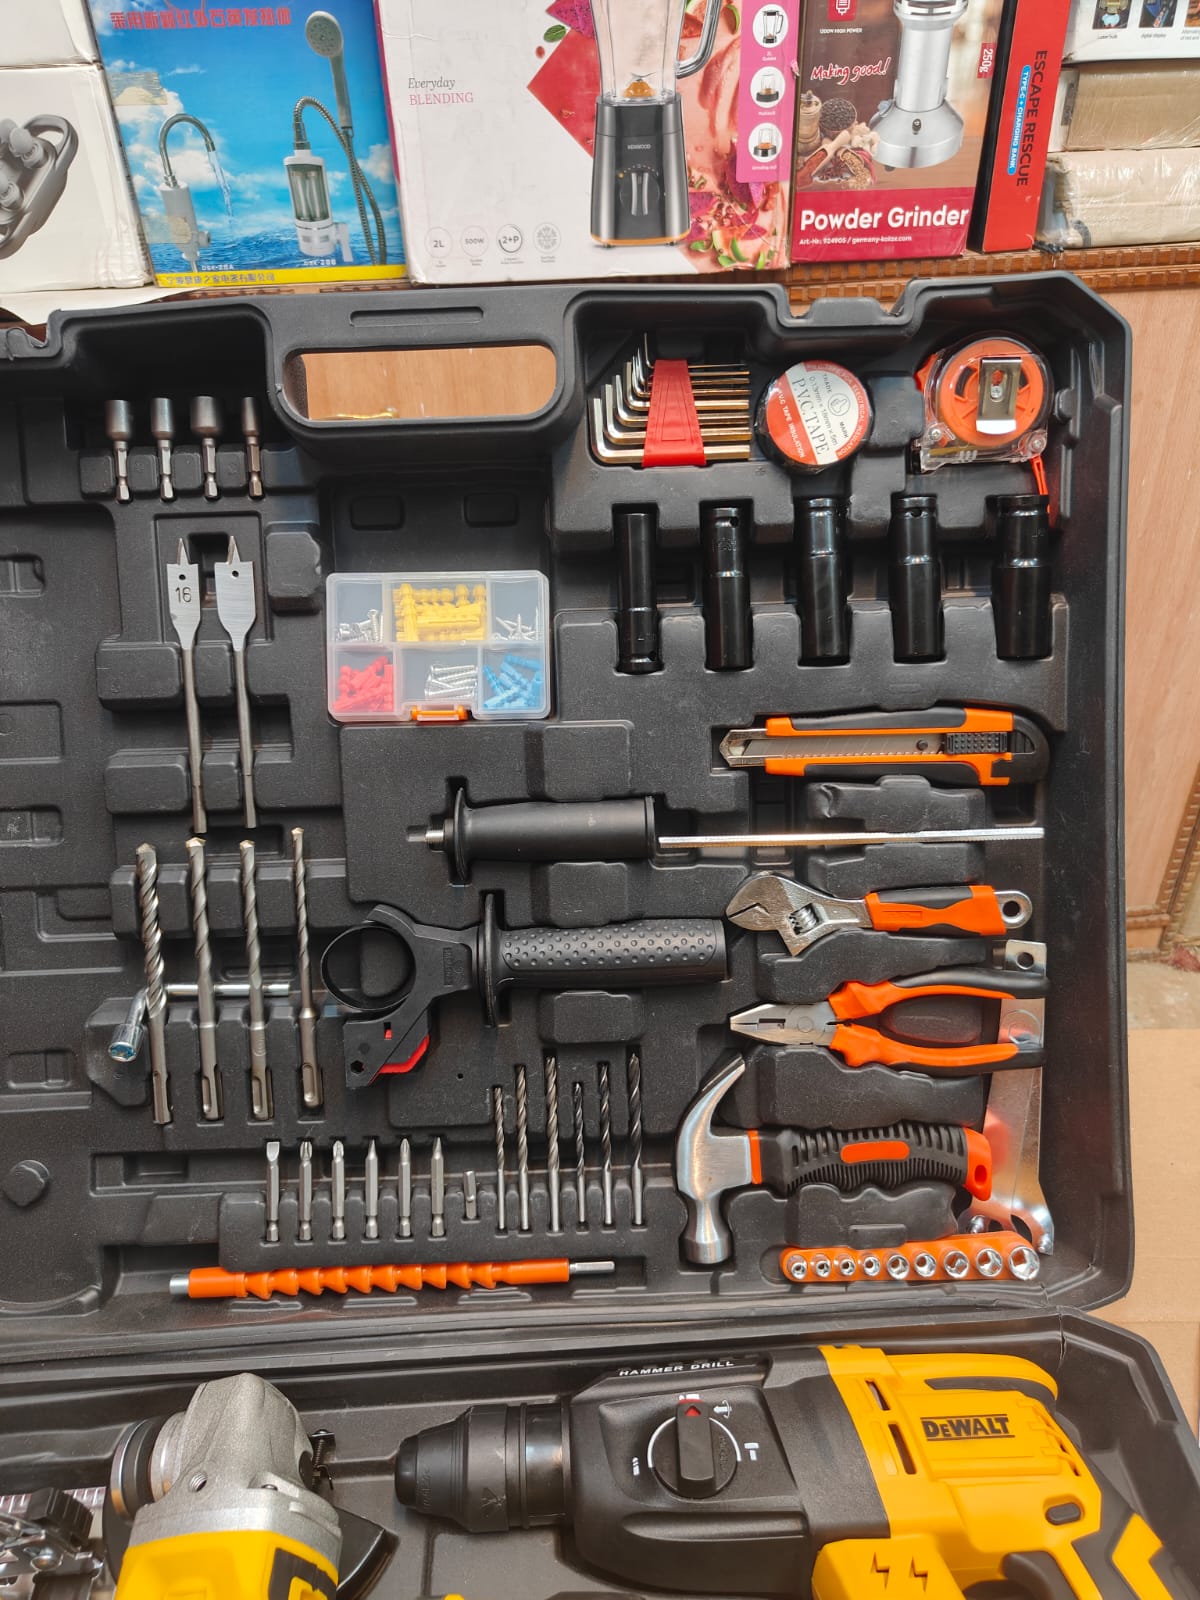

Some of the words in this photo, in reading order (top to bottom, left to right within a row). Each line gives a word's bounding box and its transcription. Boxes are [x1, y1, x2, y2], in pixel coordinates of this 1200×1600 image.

[810, 63, 850, 86] Making
[850, 56, 892, 82] good!
[978, 48, 994, 73] 250g
[408, 76, 456, 91] Everyday
[1019, 71, 1029, 99] TYPE-C
[1026, 50, 1048, 117] ESCAPE
[409, 92, 474, 105] BLENDING
[1013, 107, 1024, 147] CHARGING
[1009, 148, 1018, 169] BANK
[1016, 123, 1036, 186] RESCUE
[800, 208, 883, 231] Powder
[887, 205, 970, 228] Grinder
[433, 240, 444, 248] 2L
[502, 235, 519, 244] 2+P
[175, 586, 192, 604] 16
[619, 1365, 684, 1377] HAMMER
[690, 1361, 734, 1370] DRILL
